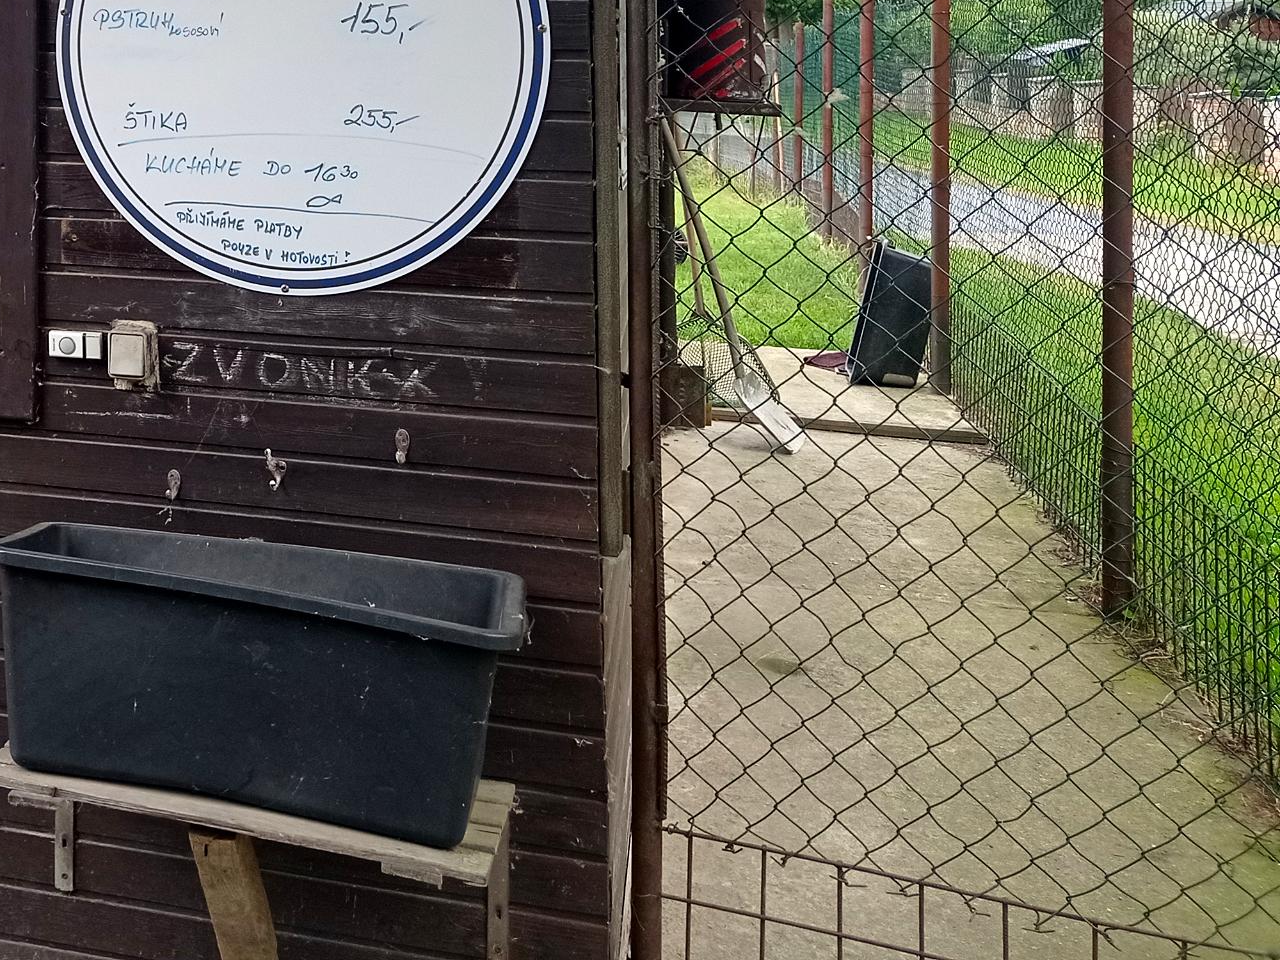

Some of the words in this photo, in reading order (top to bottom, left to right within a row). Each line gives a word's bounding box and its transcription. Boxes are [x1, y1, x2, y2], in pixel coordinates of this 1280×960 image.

[92, 8, 174, 30] PSTRUH
[123, 102, 188, 132] ŠTIKA
[145, 147, 243, 177] KUCHÁME
[263, 160, 291, 176] DO
[254, 219, 303, 240] PLATBY
[221, 239, 260, 257] POUZE
[265, 249, 273, 261] V
